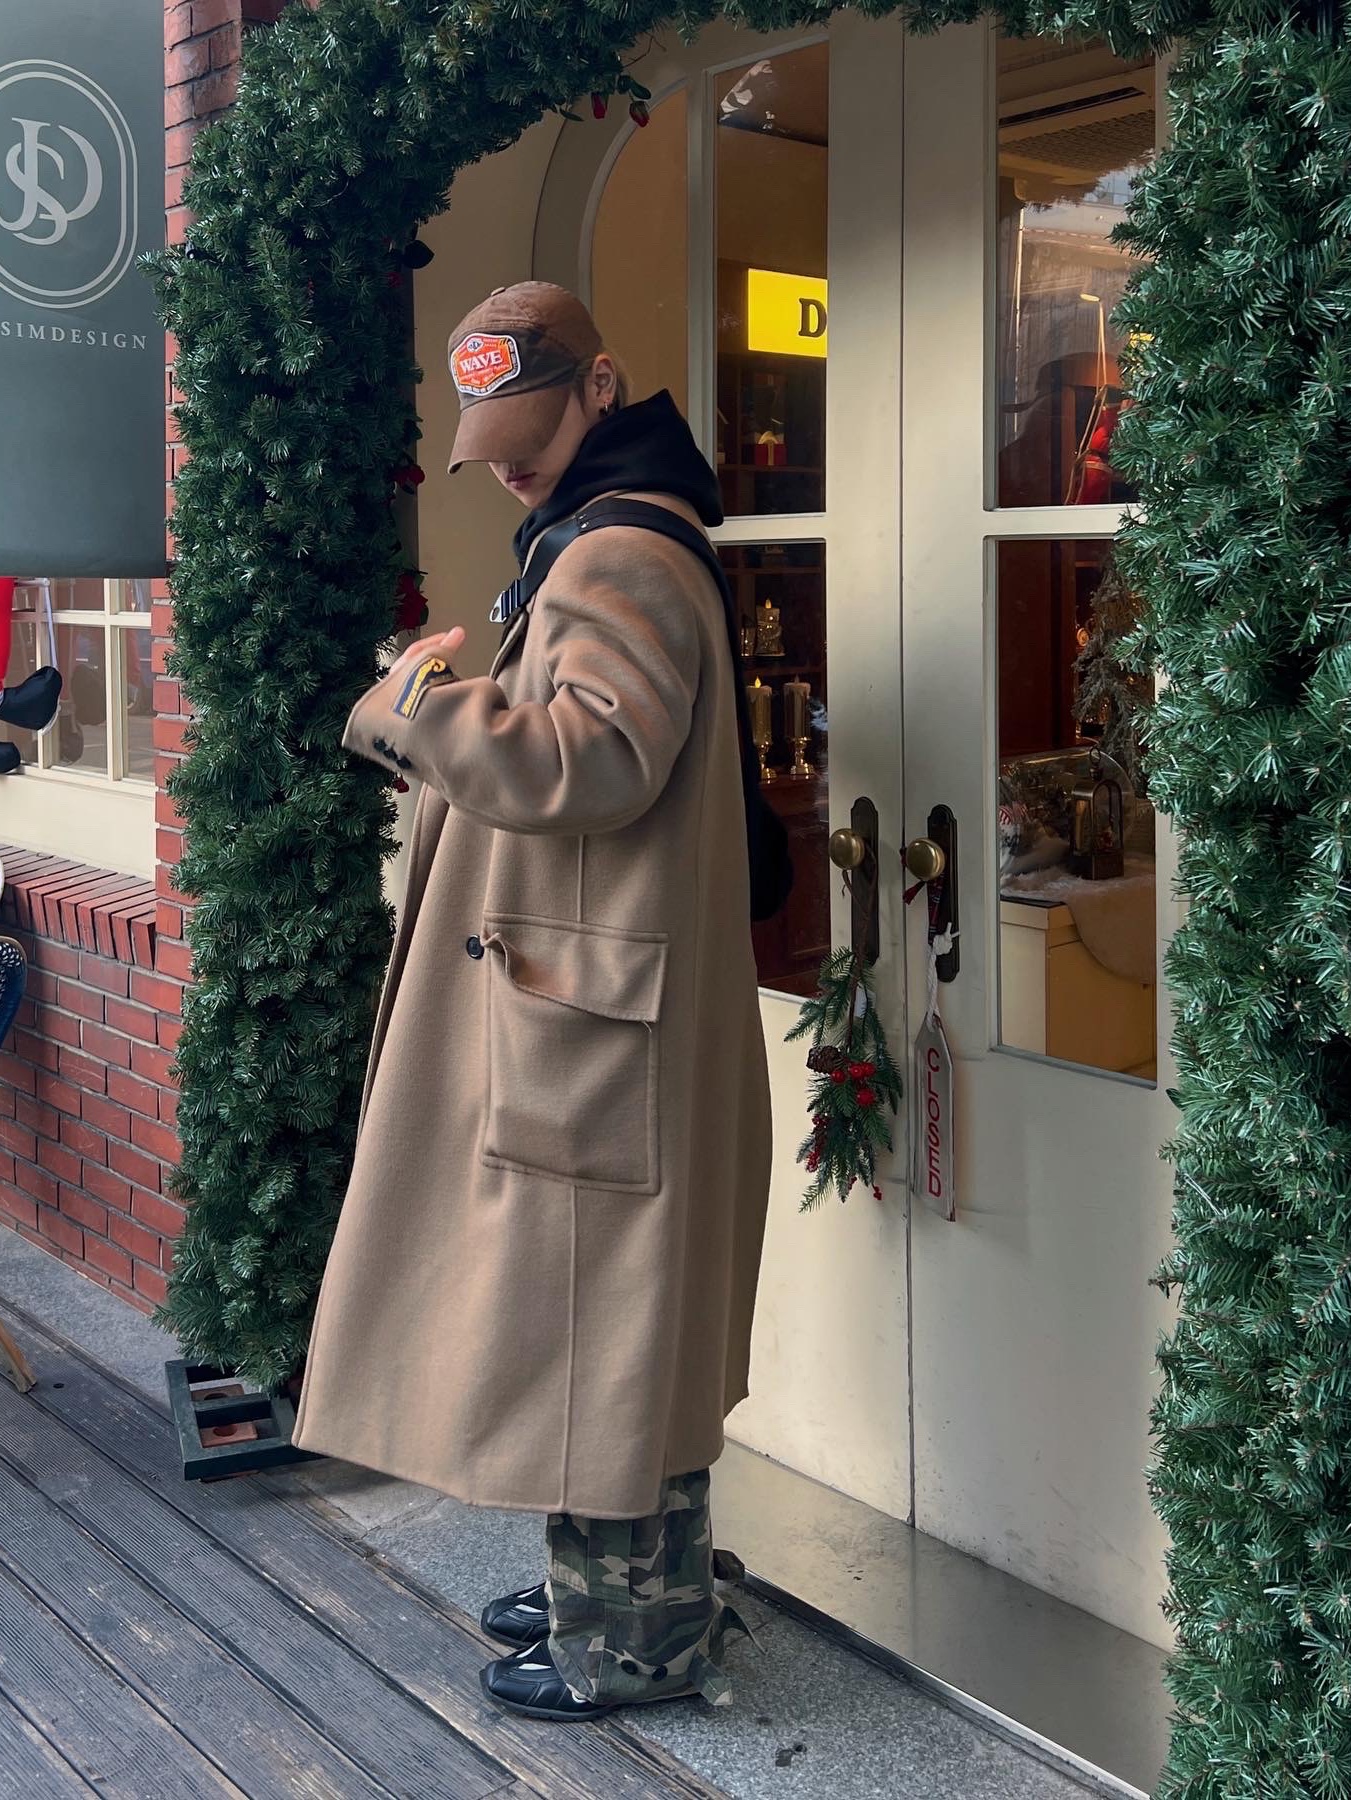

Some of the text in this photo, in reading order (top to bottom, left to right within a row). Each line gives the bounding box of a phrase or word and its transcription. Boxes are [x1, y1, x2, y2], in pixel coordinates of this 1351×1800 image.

[0, 321, 147, 350] SIMDESIGN
[459, 350, 503, 374] WAVE
[927, 1047, 942, 1198] CLOSED
